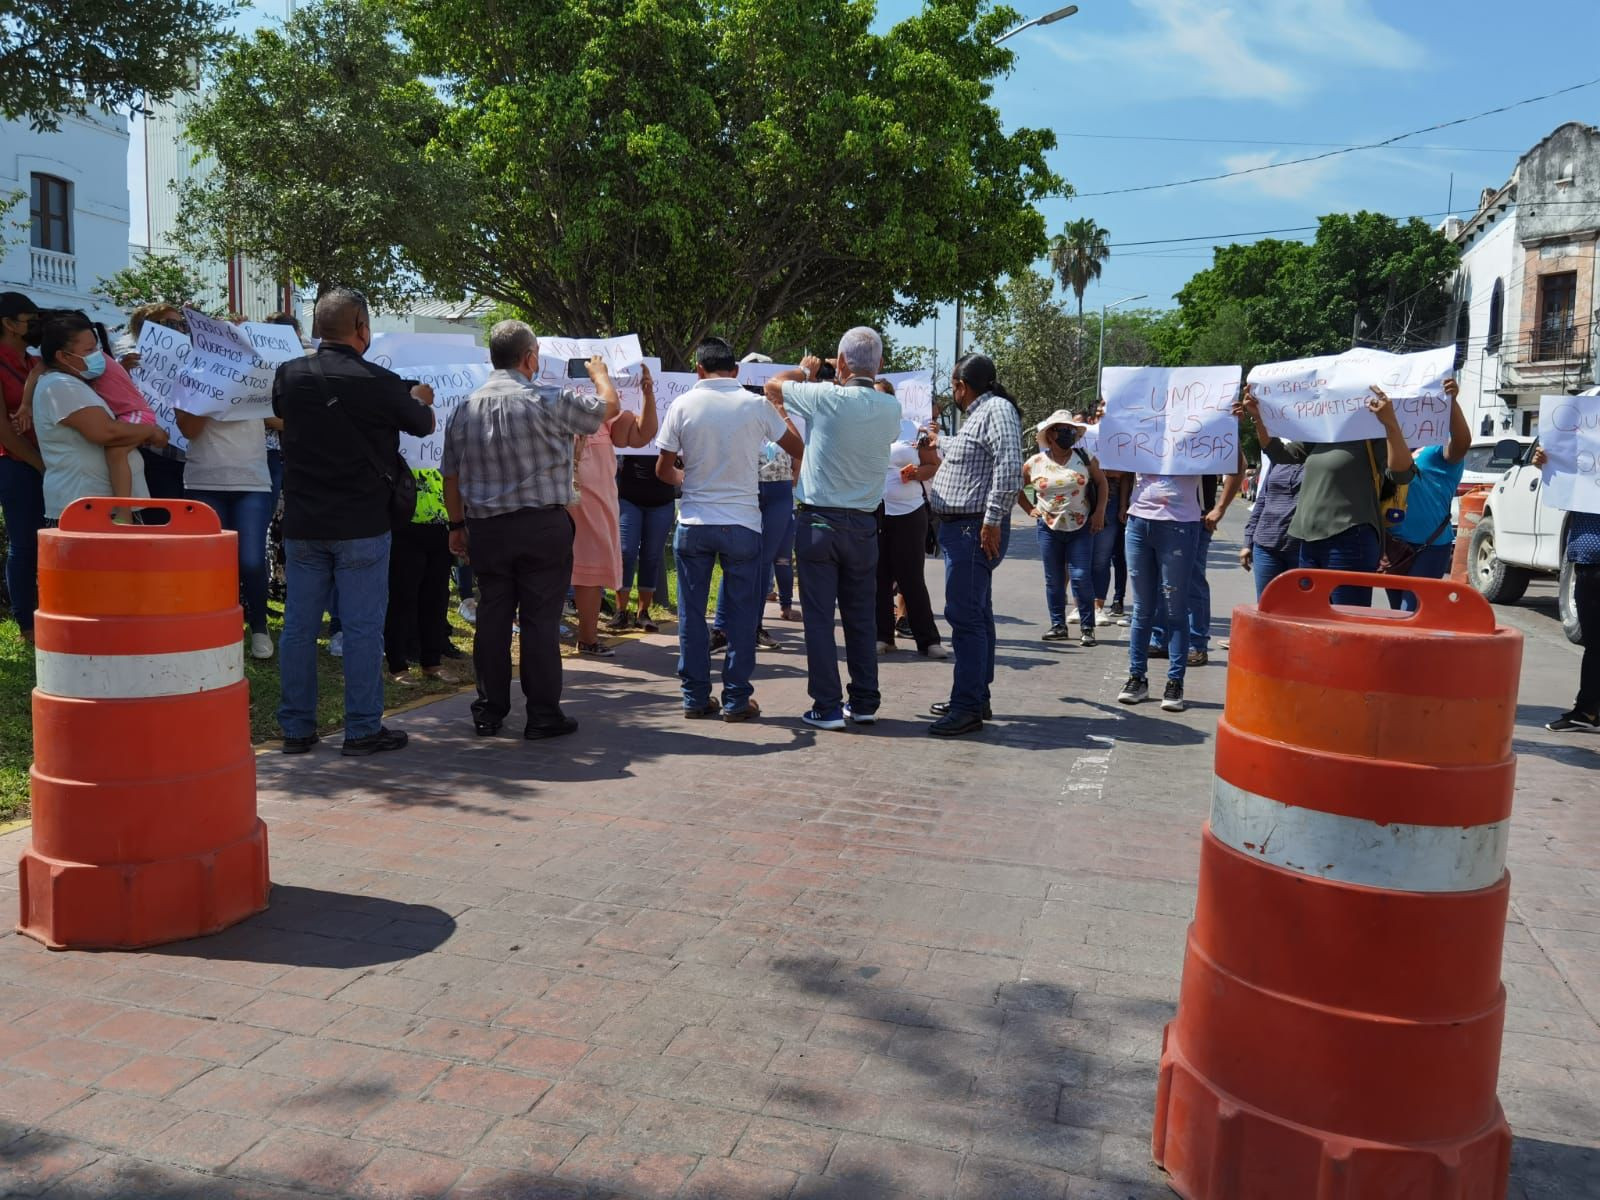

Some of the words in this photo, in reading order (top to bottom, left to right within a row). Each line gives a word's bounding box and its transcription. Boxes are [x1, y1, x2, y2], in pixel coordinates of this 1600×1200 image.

[145, 327, 173, 350] NO
[1118, 378, 1239, 413] CUMPLE
[1139, 414, 1203, 434] TUS
[1107, 432, 1234, 461] PROMESAS
